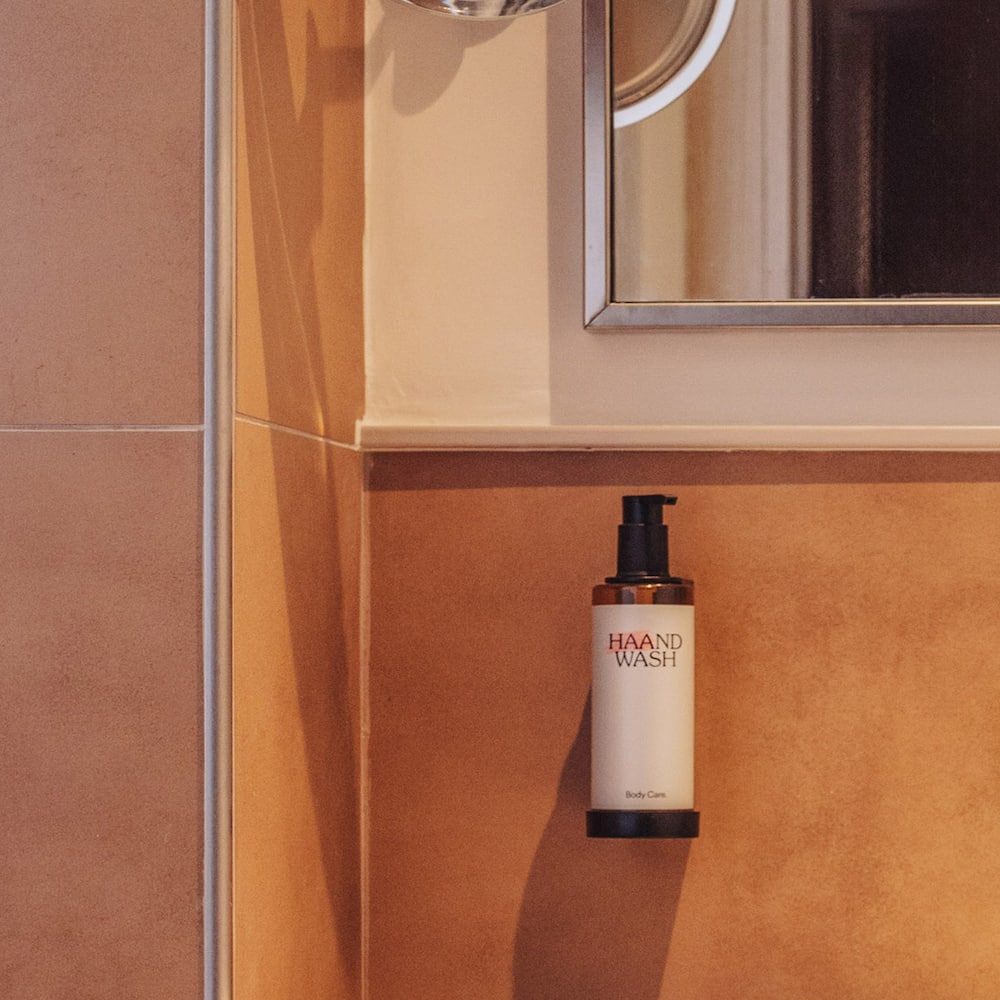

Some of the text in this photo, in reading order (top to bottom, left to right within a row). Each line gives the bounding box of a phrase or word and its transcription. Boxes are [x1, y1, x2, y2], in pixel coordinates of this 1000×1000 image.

[608, 633, 683, 650] HAAND
[615, 651, 677, 667] WASH
[625, 790, 646, 800] Body
